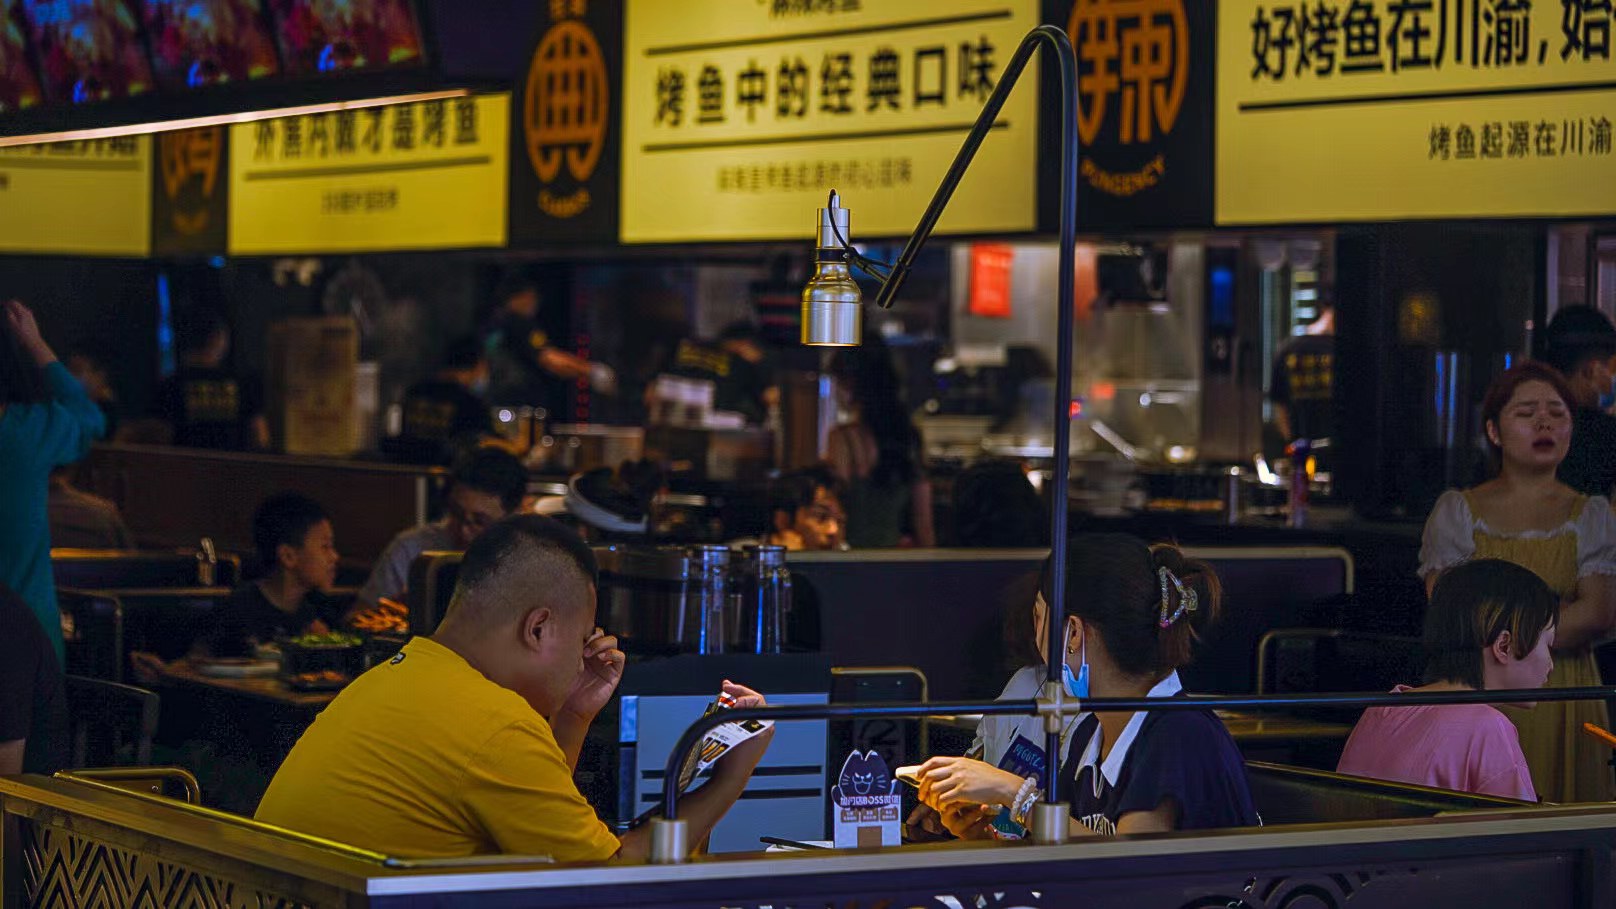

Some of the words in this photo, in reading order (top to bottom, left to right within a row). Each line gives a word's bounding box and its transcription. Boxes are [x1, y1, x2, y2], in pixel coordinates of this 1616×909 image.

[653, 36, 997, 127] 烤鱼中的经典口味
[1251, 0, 1616, 82] 好烤鱼在川渝,始
[1428, 116, 1612, 160] 烤鱼起源在川渝
